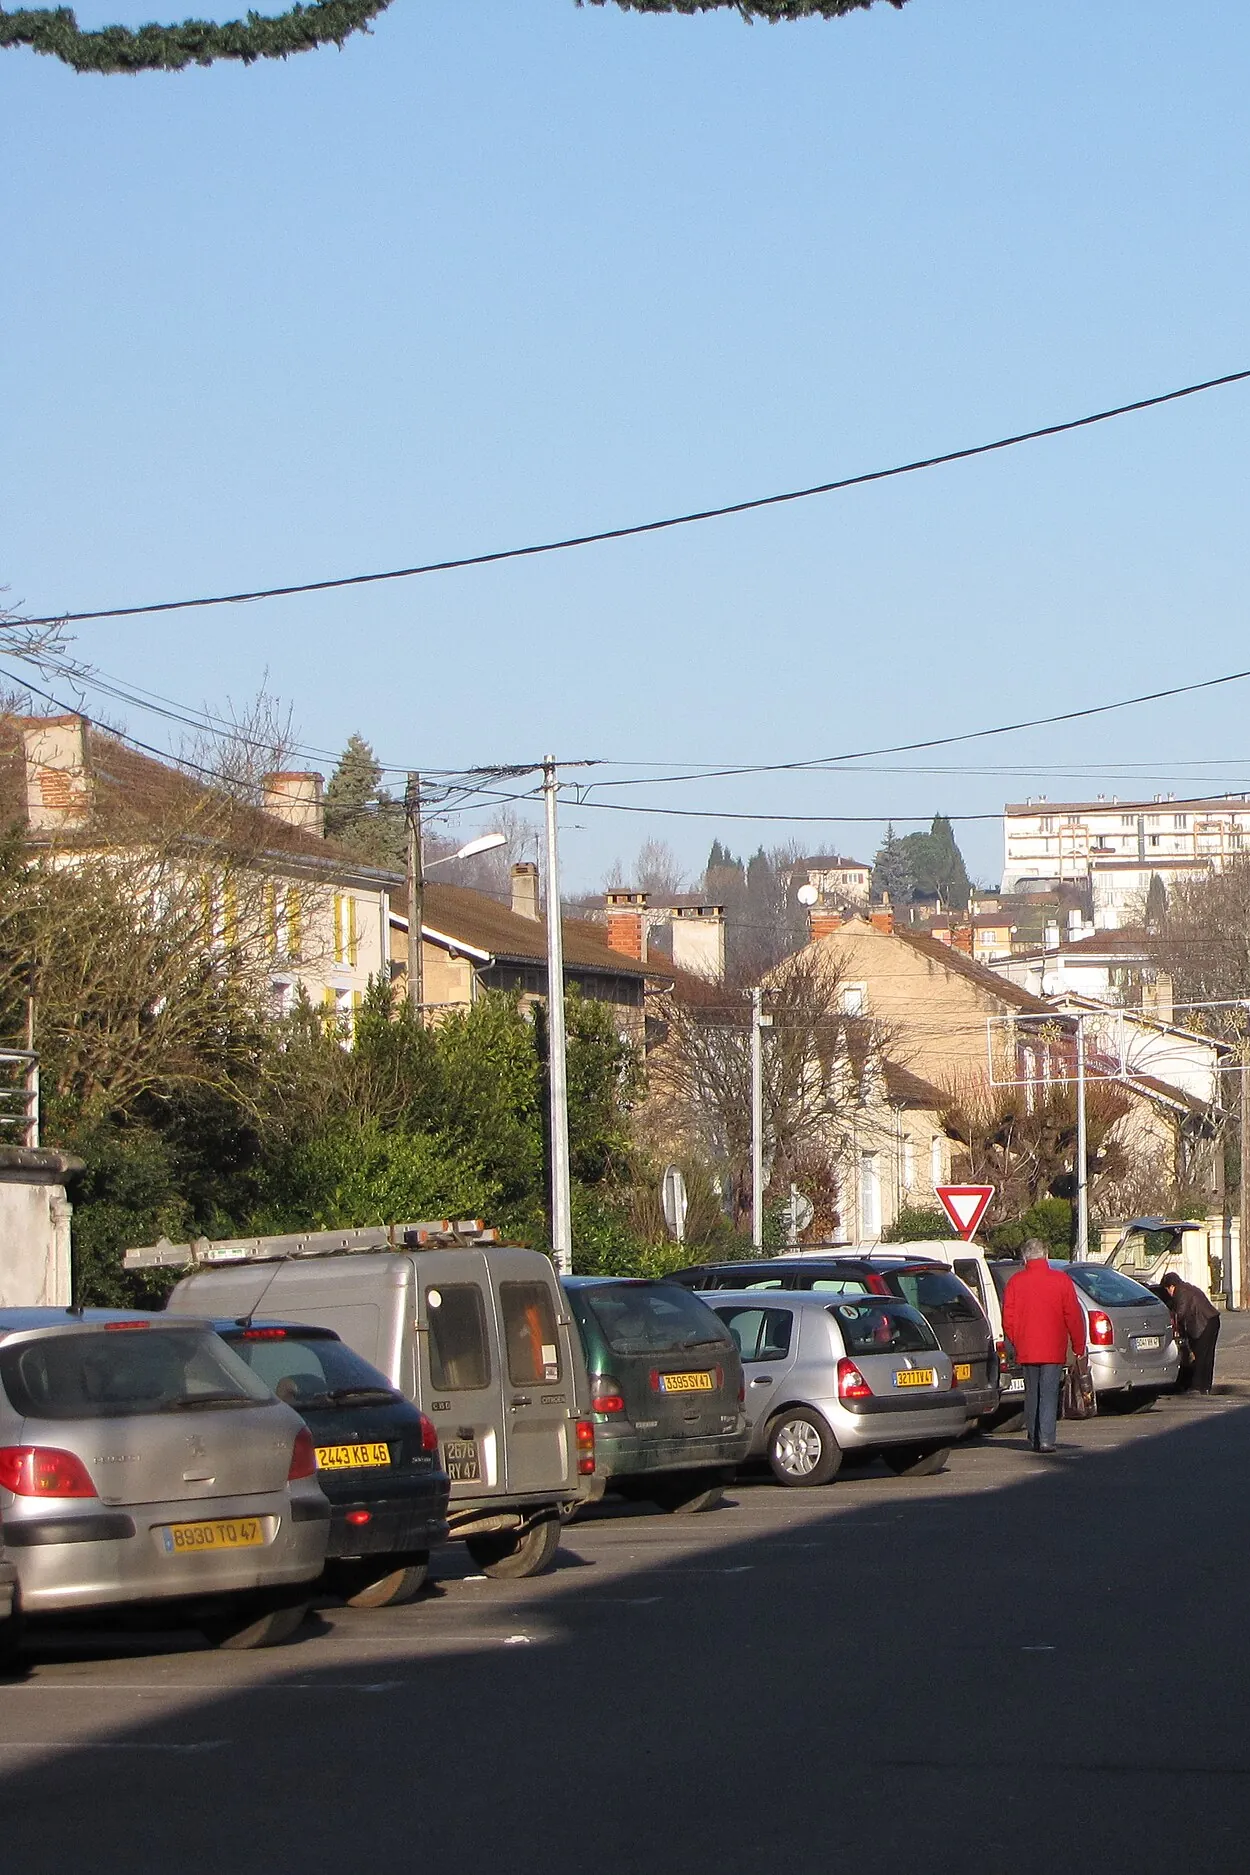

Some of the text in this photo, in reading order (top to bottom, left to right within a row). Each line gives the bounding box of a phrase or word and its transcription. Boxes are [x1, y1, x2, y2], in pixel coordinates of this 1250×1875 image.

[665, 1374, 710, 1390] 3395 SV 47
[897, 1371, 915, 1385] 3277
[319, 1444, 387, 1467] 2443 KB 46
[447, 1443, 475, 1459] 2676
[448, 1463, 477, 1480] RY 47
[174, 1527, 214, 1547] 8930
[240, 1523, 257, 1540] 47
